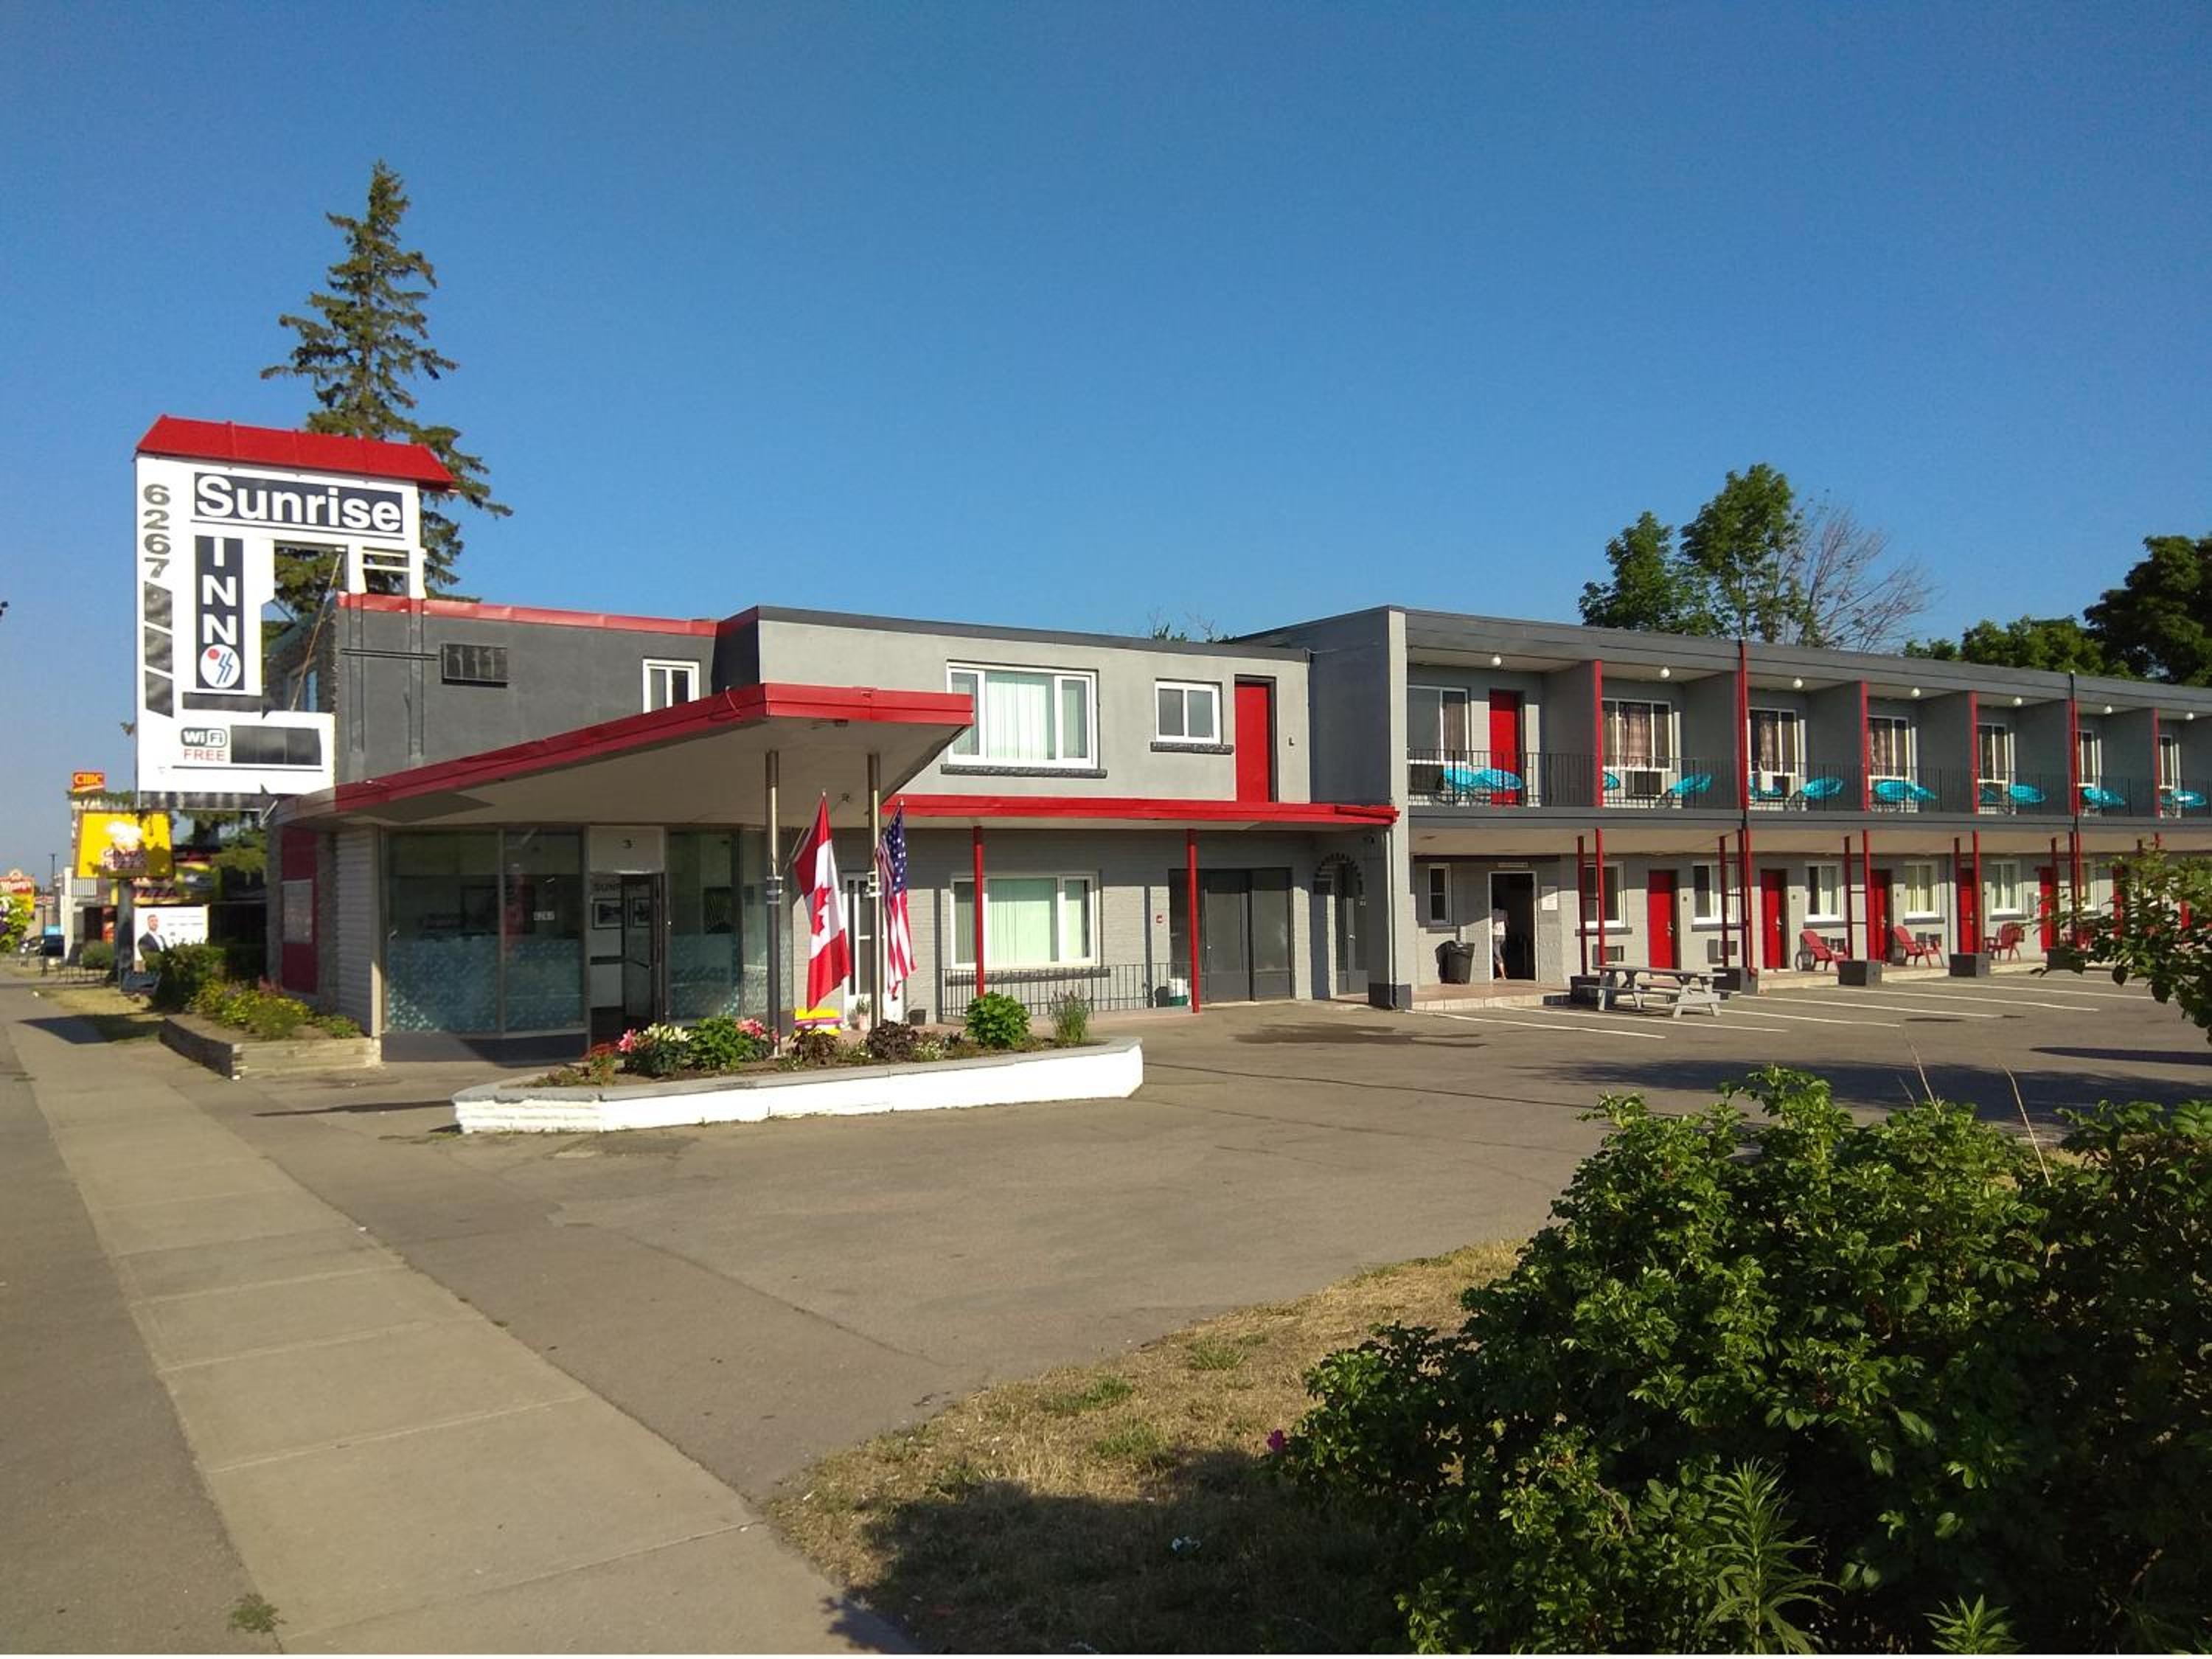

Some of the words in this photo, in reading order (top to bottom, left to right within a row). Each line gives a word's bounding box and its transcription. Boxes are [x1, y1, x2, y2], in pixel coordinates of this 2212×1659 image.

[143, 484, 171, 578] 6267
[197, 476, 402, 532] Sunrise
[203, 537, 237, 645] INN
[184, 749, 224, 761] FREE
